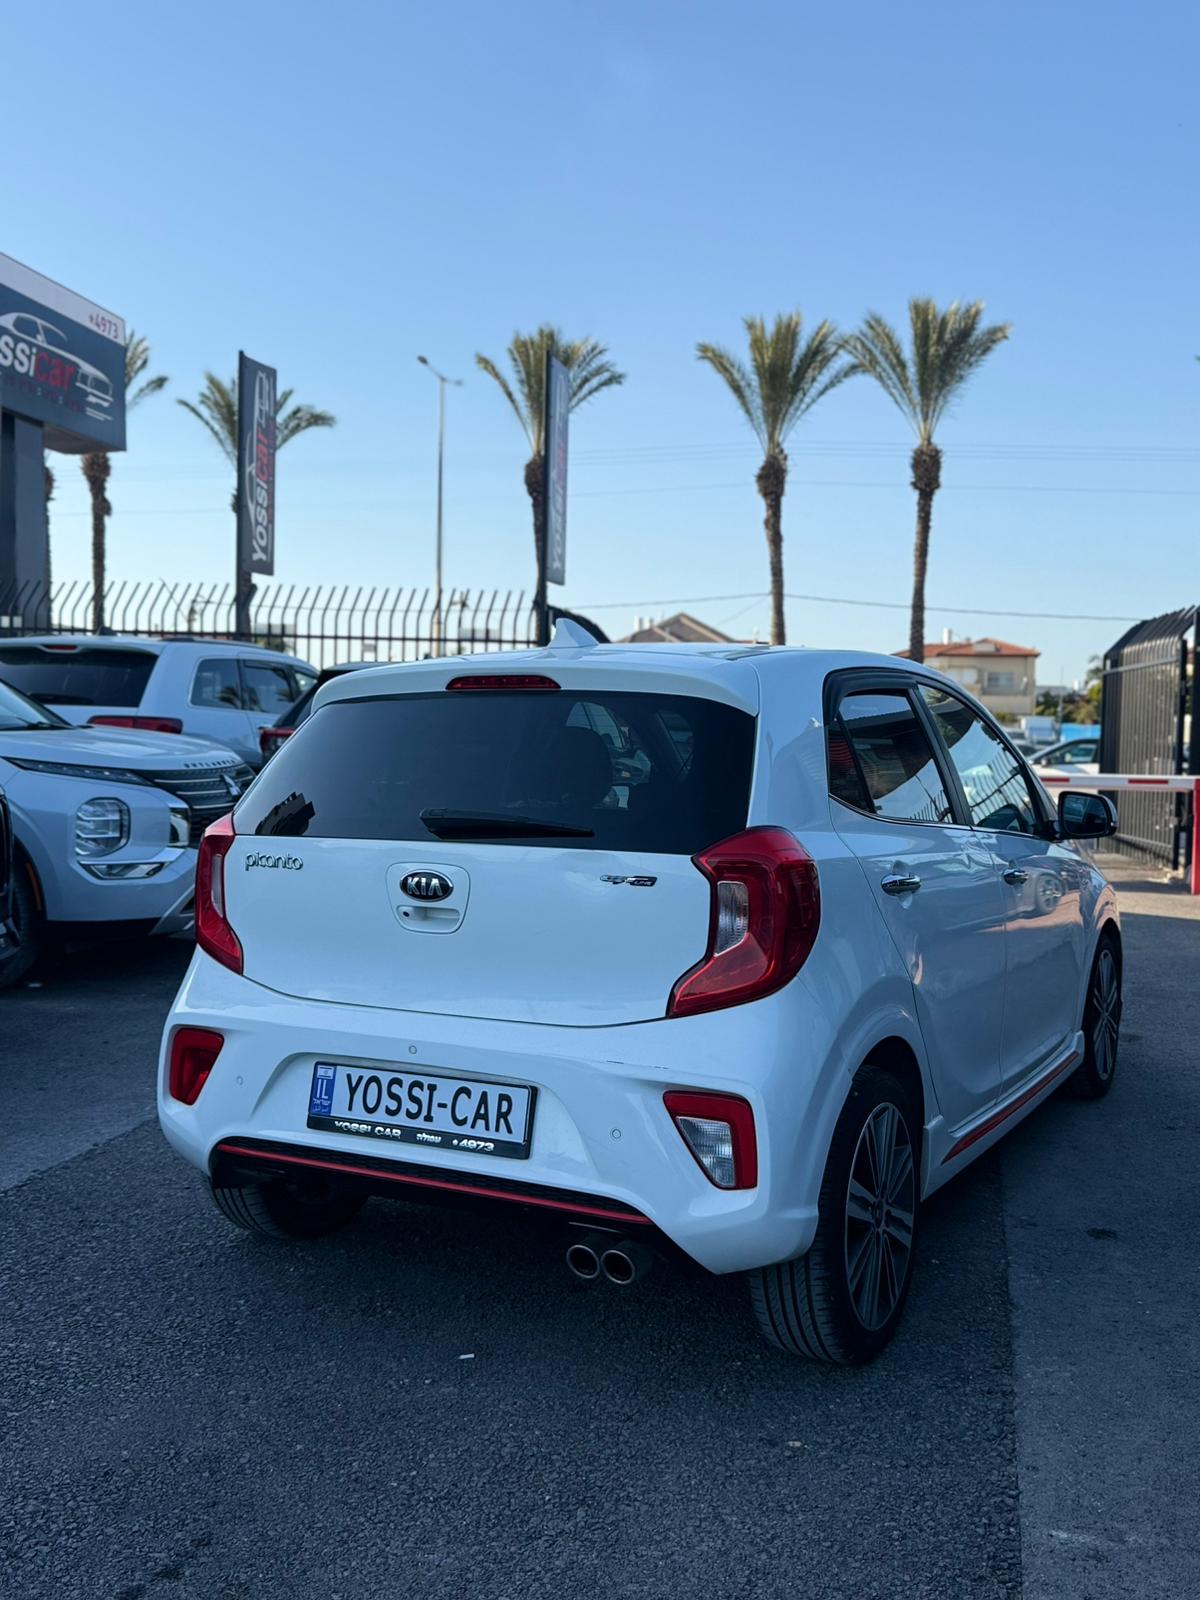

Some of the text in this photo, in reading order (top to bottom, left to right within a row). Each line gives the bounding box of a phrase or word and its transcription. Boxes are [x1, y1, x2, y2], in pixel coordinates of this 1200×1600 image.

[244, 852, 304, 871] picanto
[407, 877, 444, 896] KIA
[316, 1078, 329, 1099] IL
[346, 1073, 513, 1134] YOSSI-CAR
[335, 1121, 371, 1132] YOSSI
[375, 1126, 401, 1139] CAR
